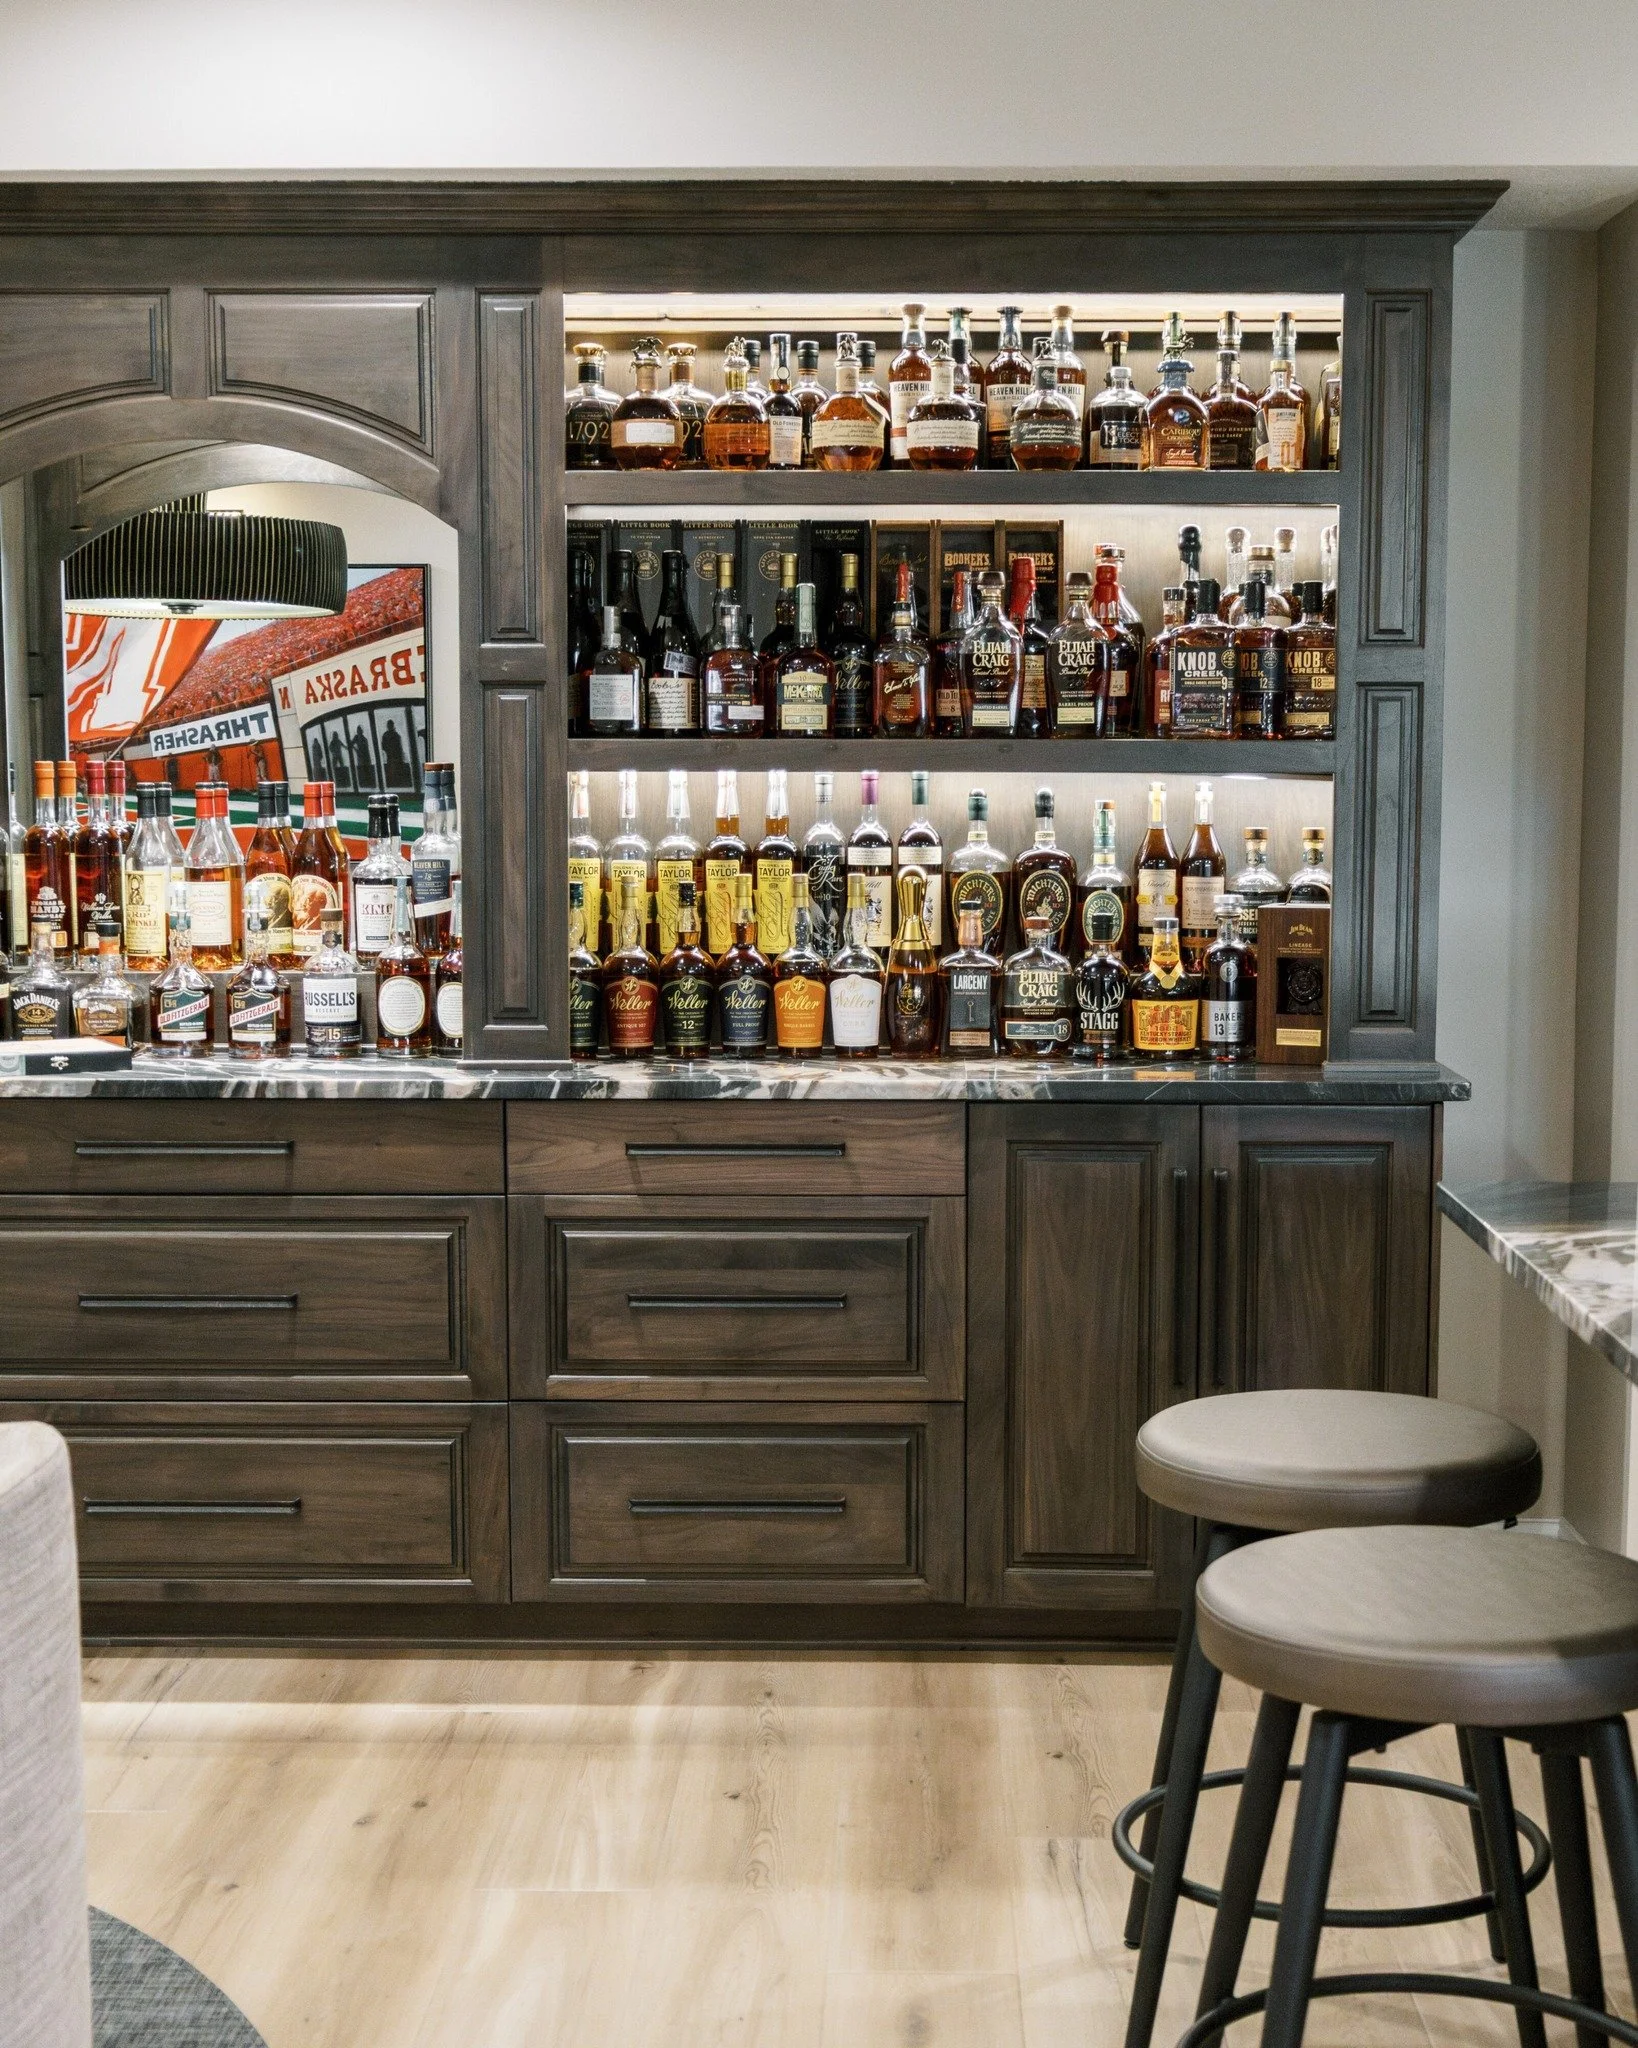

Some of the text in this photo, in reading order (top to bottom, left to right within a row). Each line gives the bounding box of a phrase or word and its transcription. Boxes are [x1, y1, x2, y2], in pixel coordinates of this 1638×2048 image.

[920, 384, 931, 392] HIL
[990, 387, 1029, 396] HEAVEN HILL
[569, 421, 609, 445] 1792
[1162, 428, 1200, 436] CARIBOU
[945, 552, 990, 567] BOOKER'S
[972, 640, 1012, 655] ELIJAH
[1058, 640, 1096, 655] ELIJAH
[973, 654, 1010, 668] CRAIG
[1058, 653, 1095, 668] CRAIG
[1178, 652, 1217, 671] KNOB
[1287, 651, 1321, 668] KNOB
[1222, 677, 1228, 690] 9
[1260, 678, 1268, 689] 12
[1314, 678, 1322, 688] 18
[570, 866, 599, 875] TAYLOR
[660, 870, 691, 878] TAYLOR
[707, 868, 738, 877] TAYLOR
[759, 868, 790, 877] TAYLOR
[959, 879, 996, 903] MICHTER'S
[1027, 879, 1065, 904] MICHTER'S
[30, 905, 66, 914] HANDY
[953, 975, 988, 990] LARCENY
[1019, 970, 1058, 985] ELIJAH
[1018, 983, 1058, 999] CRAIG
[13, 993, 60, 1011] JACK DANIEL'S
[305, 992, 355, 1007] RUSSELL'S
[570, 995, 593, 1010] ller
[610, 991, 653, 1010] Weller
[668, 990, 708, 1009] Weller
[724, 990, 766, 1010] Weller
[779, 991, 821, 1010] Weller
[835, 990, 874, 1009] Weller
[160, 1013, 171, 1024] OLD
[171, 998, 208, 1021] FITZGERALD
[230, 1001, 279, 1024] OLD FITZGERALD
[682, 1020, 695, 1030] 12
[1080, 1012, 1119, 1030] STAGG
[327, 1028, 341, 1041] 15
[1058, 1025, 1068, 1034] 18
[1215, 1024, 1225, 1036] 13
